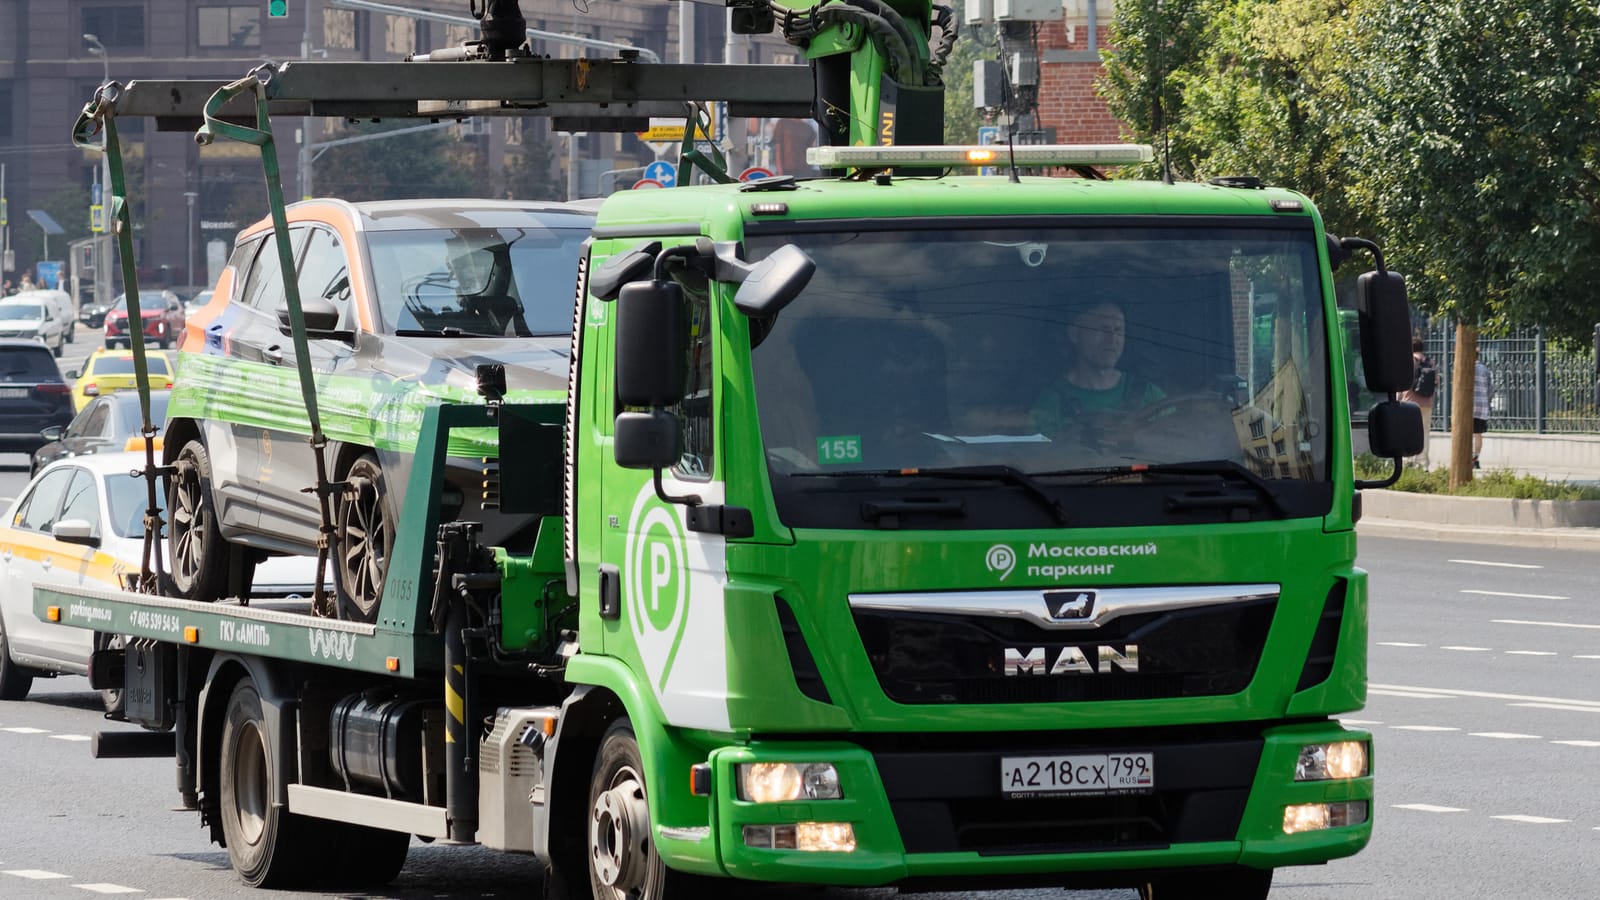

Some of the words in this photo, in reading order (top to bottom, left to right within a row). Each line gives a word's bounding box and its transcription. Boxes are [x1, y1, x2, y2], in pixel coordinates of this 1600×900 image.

[821, 440, 858, 459] 155
[1028, 542, 1157, 558] Московский
[1028, 563, 1114, 580] паркинг
[390, 578, 412, 601] 0155
[70, 601, 112, 621] parking.mos.ru
[138, 613, 150, 627] 495
[150, 615, 161, 630] 539
[162, 616, 170, 631] 54
[170, 617, 179, 632] 54
[220, 621, 235, 641] ГКУ
[236, 623, 270, 646] «АМПП»
[1004, 645, 1139, 676] MAN
[1111, 757, 1146, 777] 799
[1119, 776, 1137, 784] RUS
